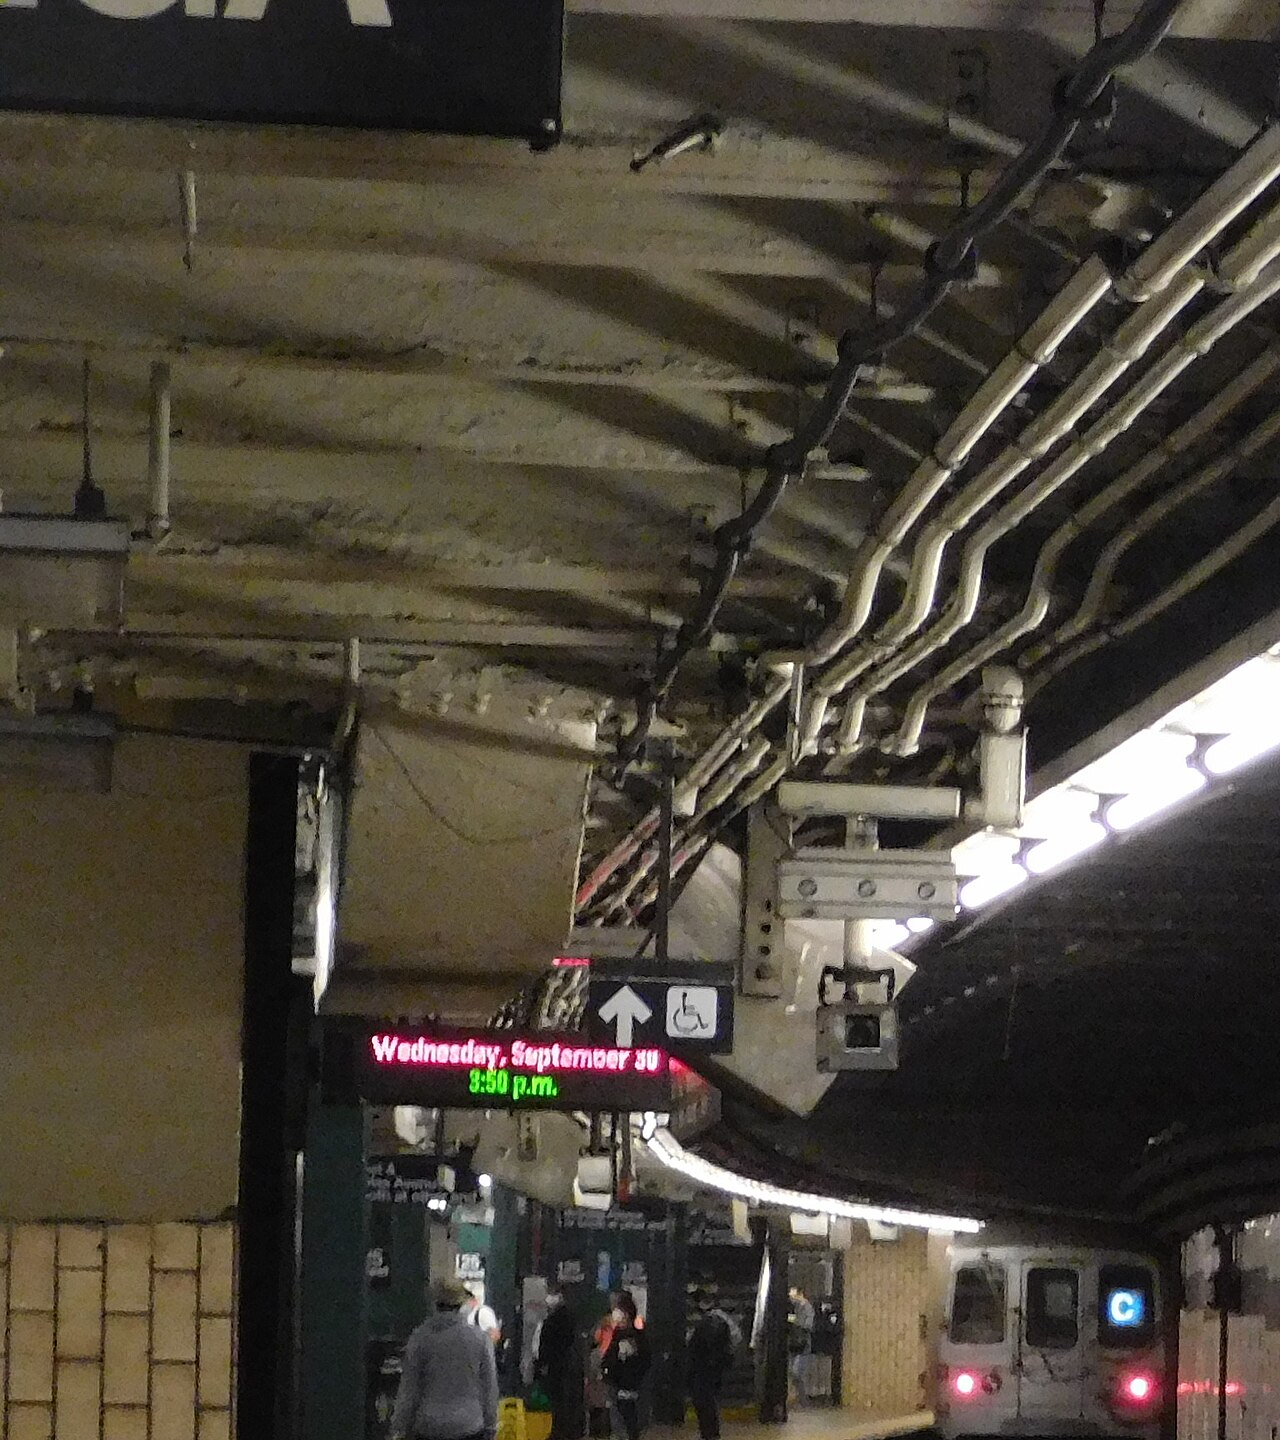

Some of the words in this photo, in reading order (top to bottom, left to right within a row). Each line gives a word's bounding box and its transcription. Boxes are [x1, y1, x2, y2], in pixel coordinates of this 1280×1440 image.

[371, 1035, 507, 1071] Wednesday,
[511, 1041, 630, 1072] September
[512, 1075, 558, 1100] p.m.
[1110, 1292, 1134, 1322] C
